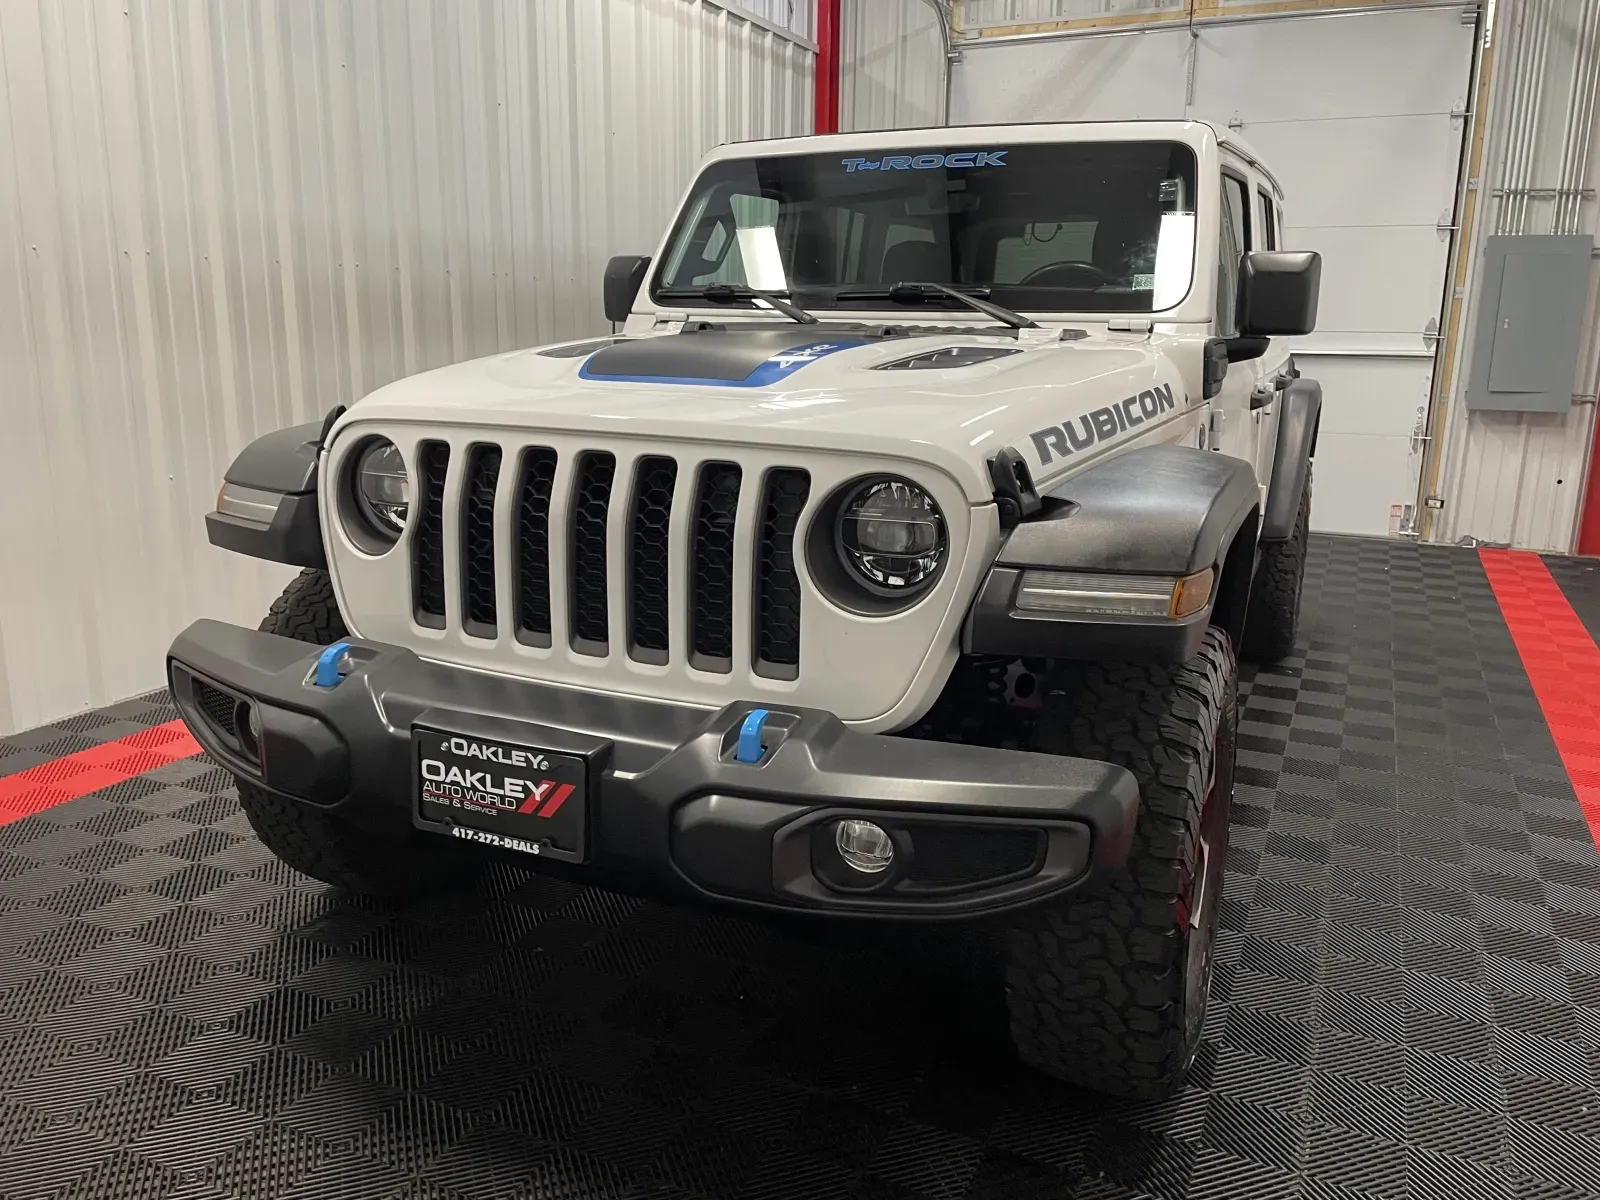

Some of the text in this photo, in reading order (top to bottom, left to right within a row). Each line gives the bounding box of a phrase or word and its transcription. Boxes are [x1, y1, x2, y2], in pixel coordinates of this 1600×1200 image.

[880, 151, 1008, 171] ROCK
[1028, 382, 1175, 466] RUBICON
[450, 737, 544, 770] OAKLEY
[421, 759, 550, 801] OAKLEY
[423, 780, 516, 809] AUTO WORLD
[423, 793, 498, 816] SALES & SERVICE
[452, 827, 540, 854] 417-272-DEALS
